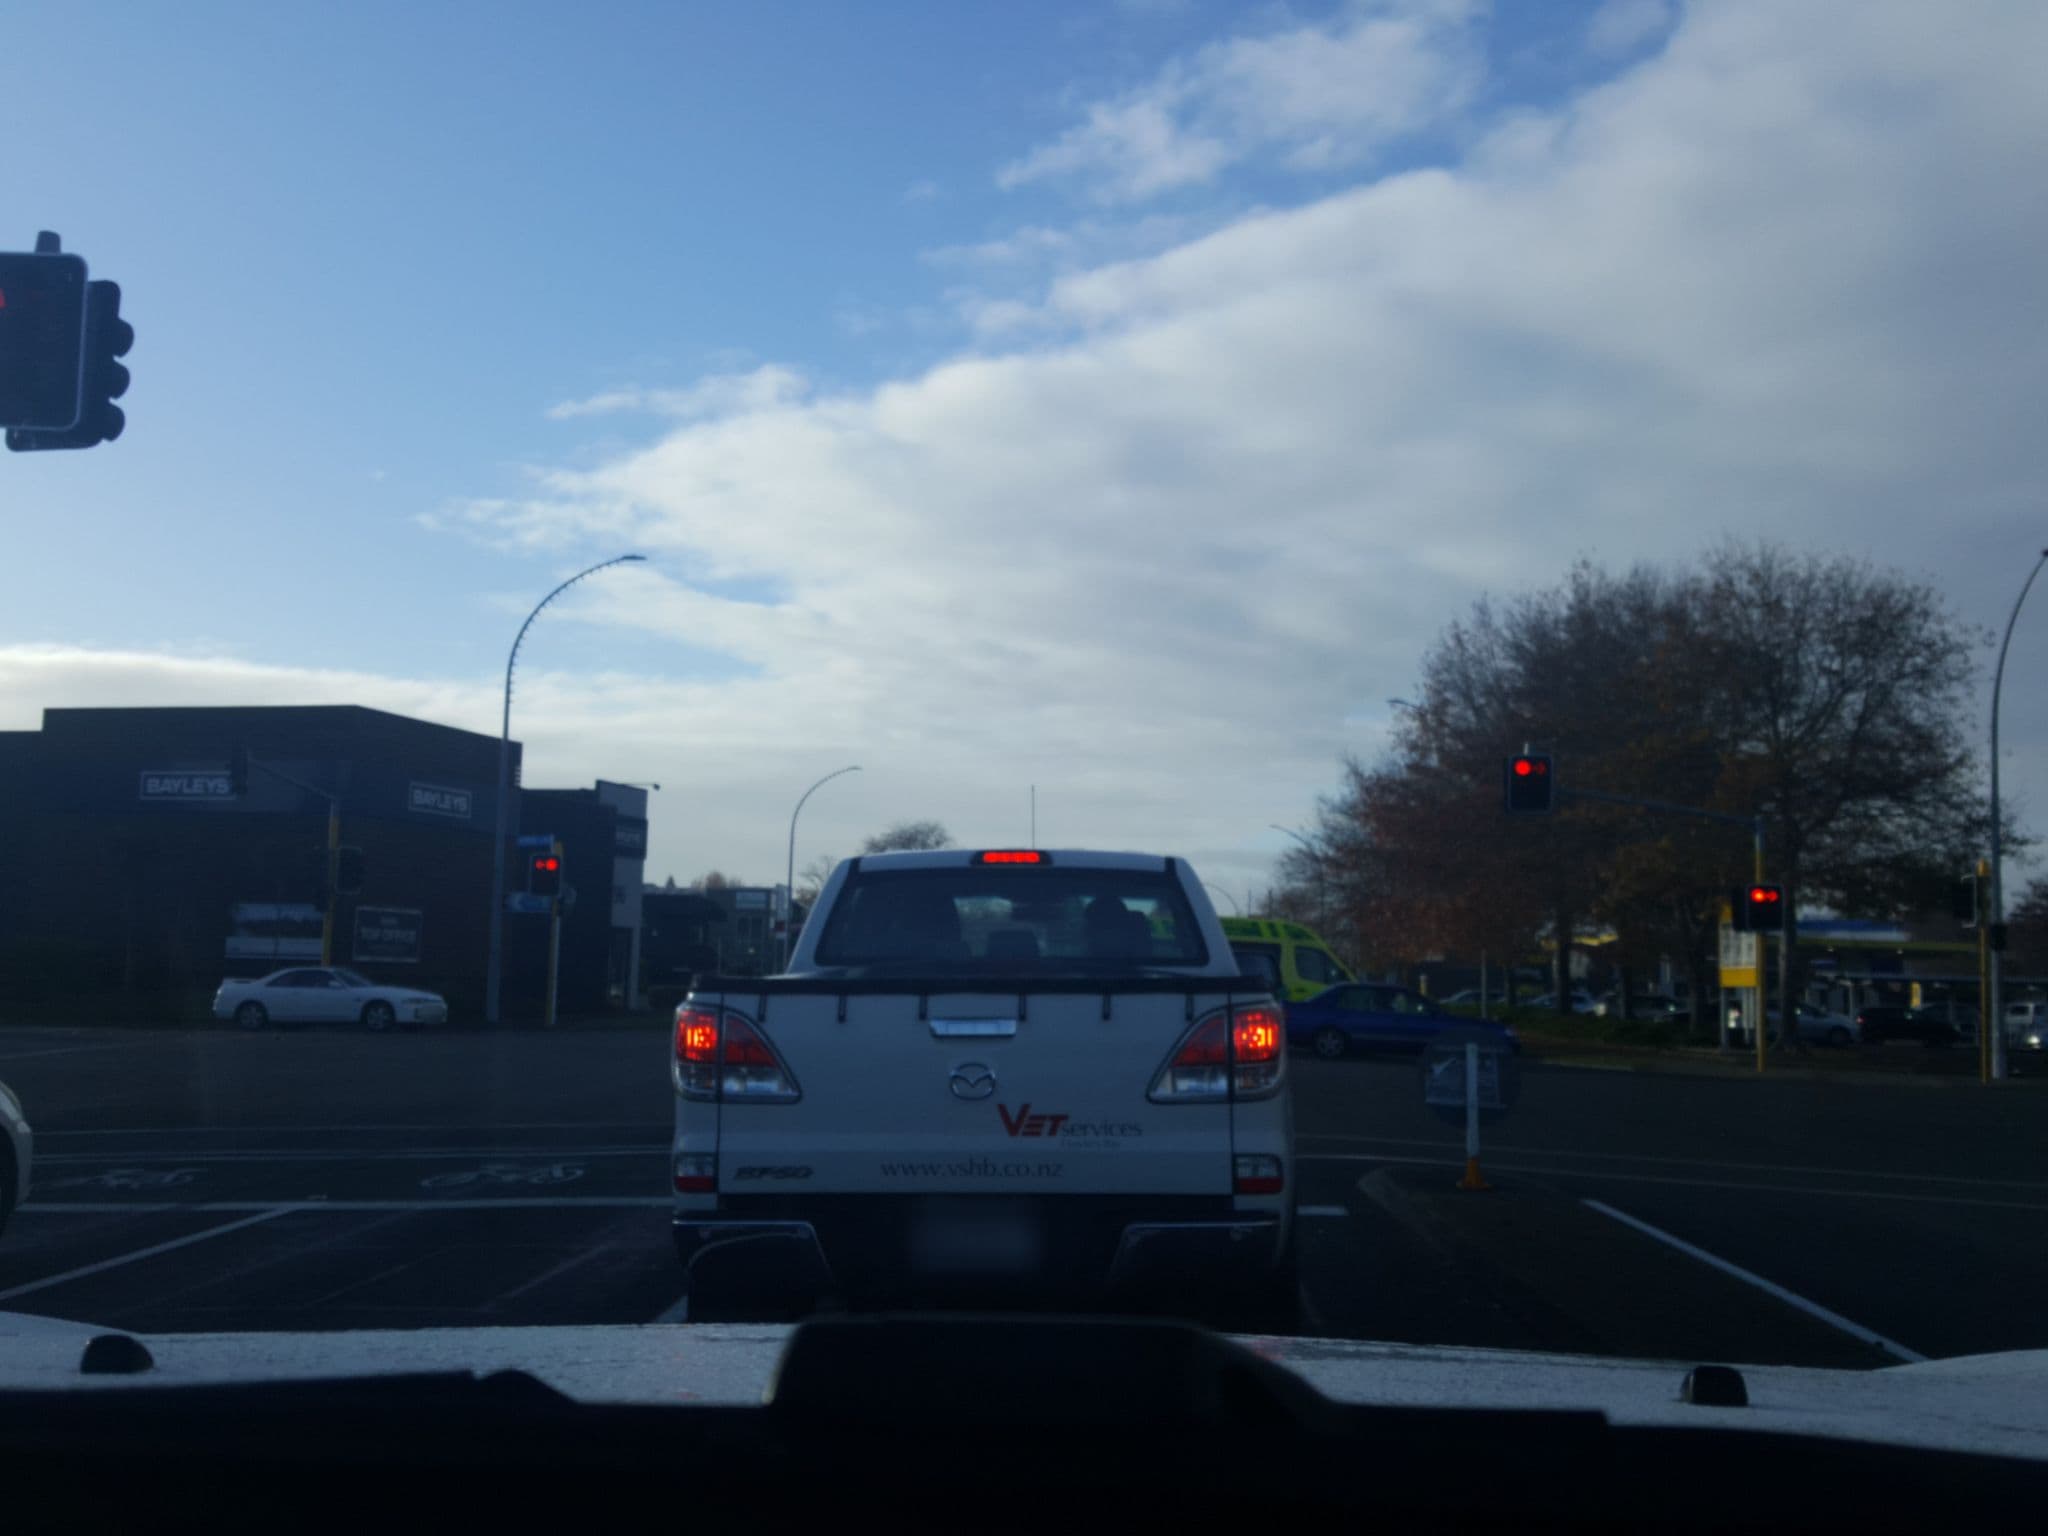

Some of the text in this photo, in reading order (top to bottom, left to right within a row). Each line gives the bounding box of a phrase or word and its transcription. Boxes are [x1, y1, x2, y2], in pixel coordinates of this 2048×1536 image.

[145, 776, 229, 794] BAYLEYS
[412, 789, 467, 811] BAYLEYS
[880, 1153, 1064, 1177] www.vshb.co.nz
